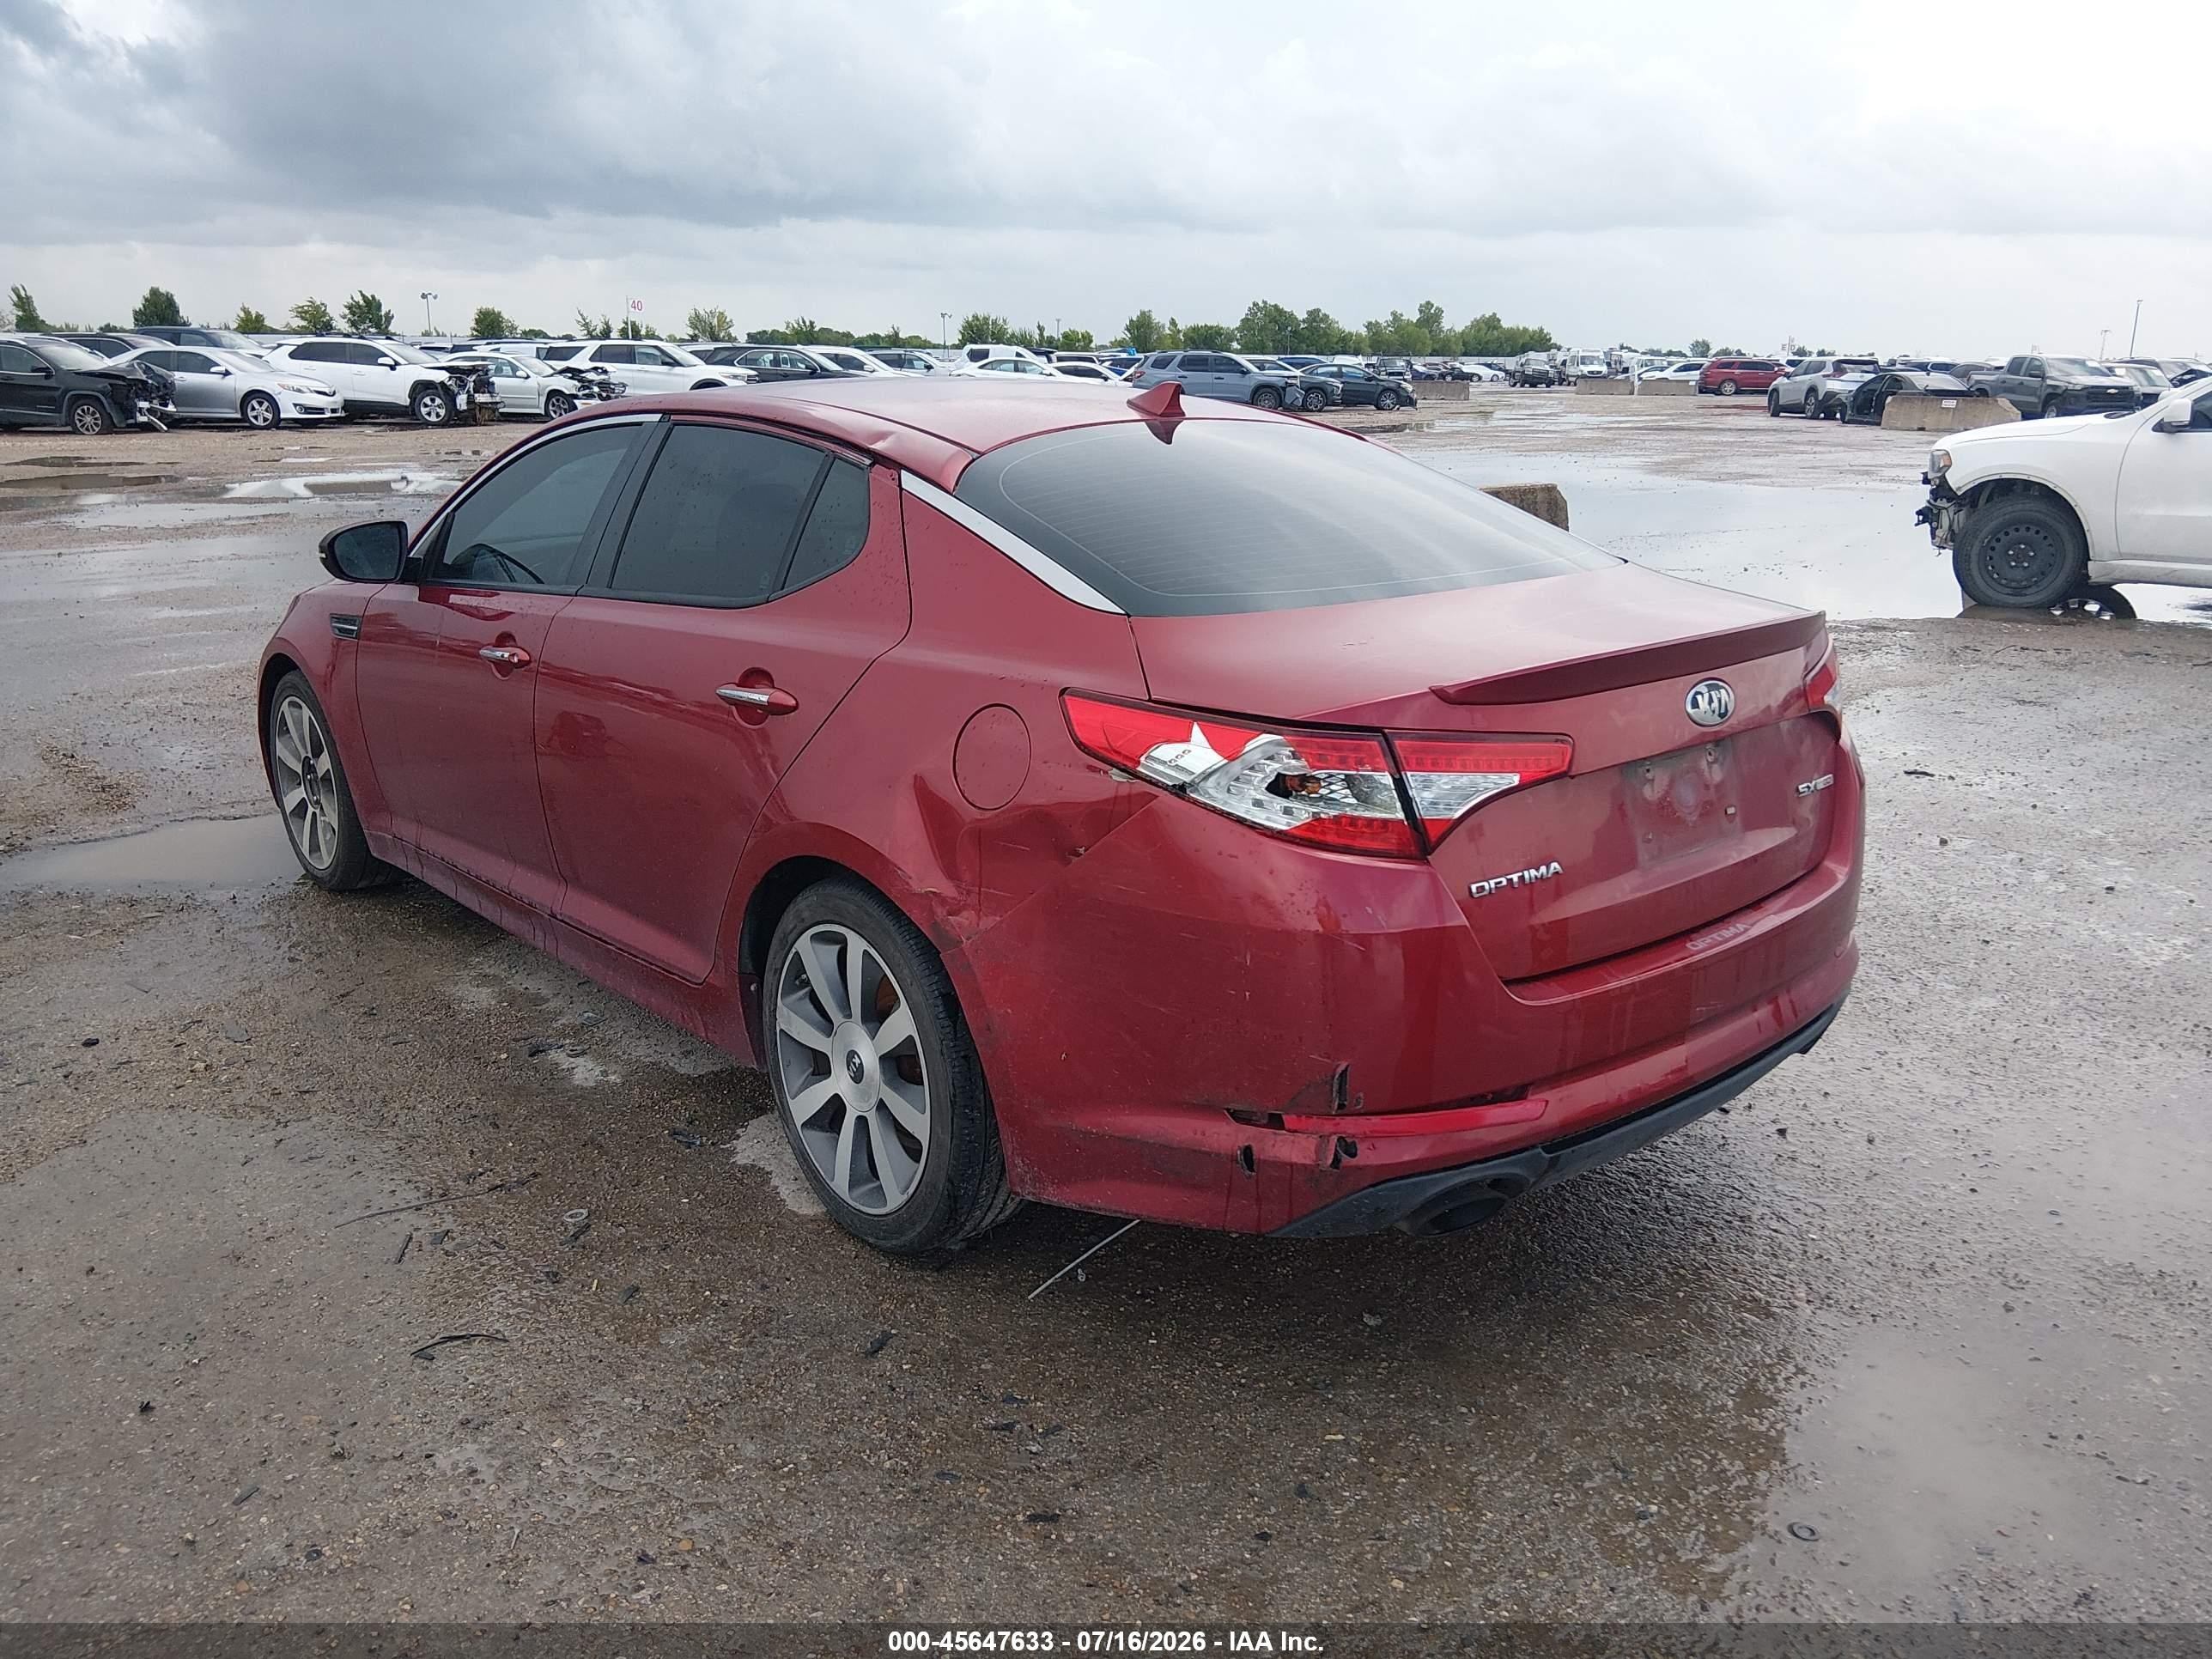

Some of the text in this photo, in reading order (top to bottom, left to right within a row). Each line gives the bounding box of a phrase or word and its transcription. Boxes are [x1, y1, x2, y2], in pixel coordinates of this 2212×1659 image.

[631, 300, 643, 311] 40
[1469, 861, 1564, 898] OPTIMA
[1685, 923, 1749, 950] OPTIMA
[848, 1054, 861, 1078] KIA
